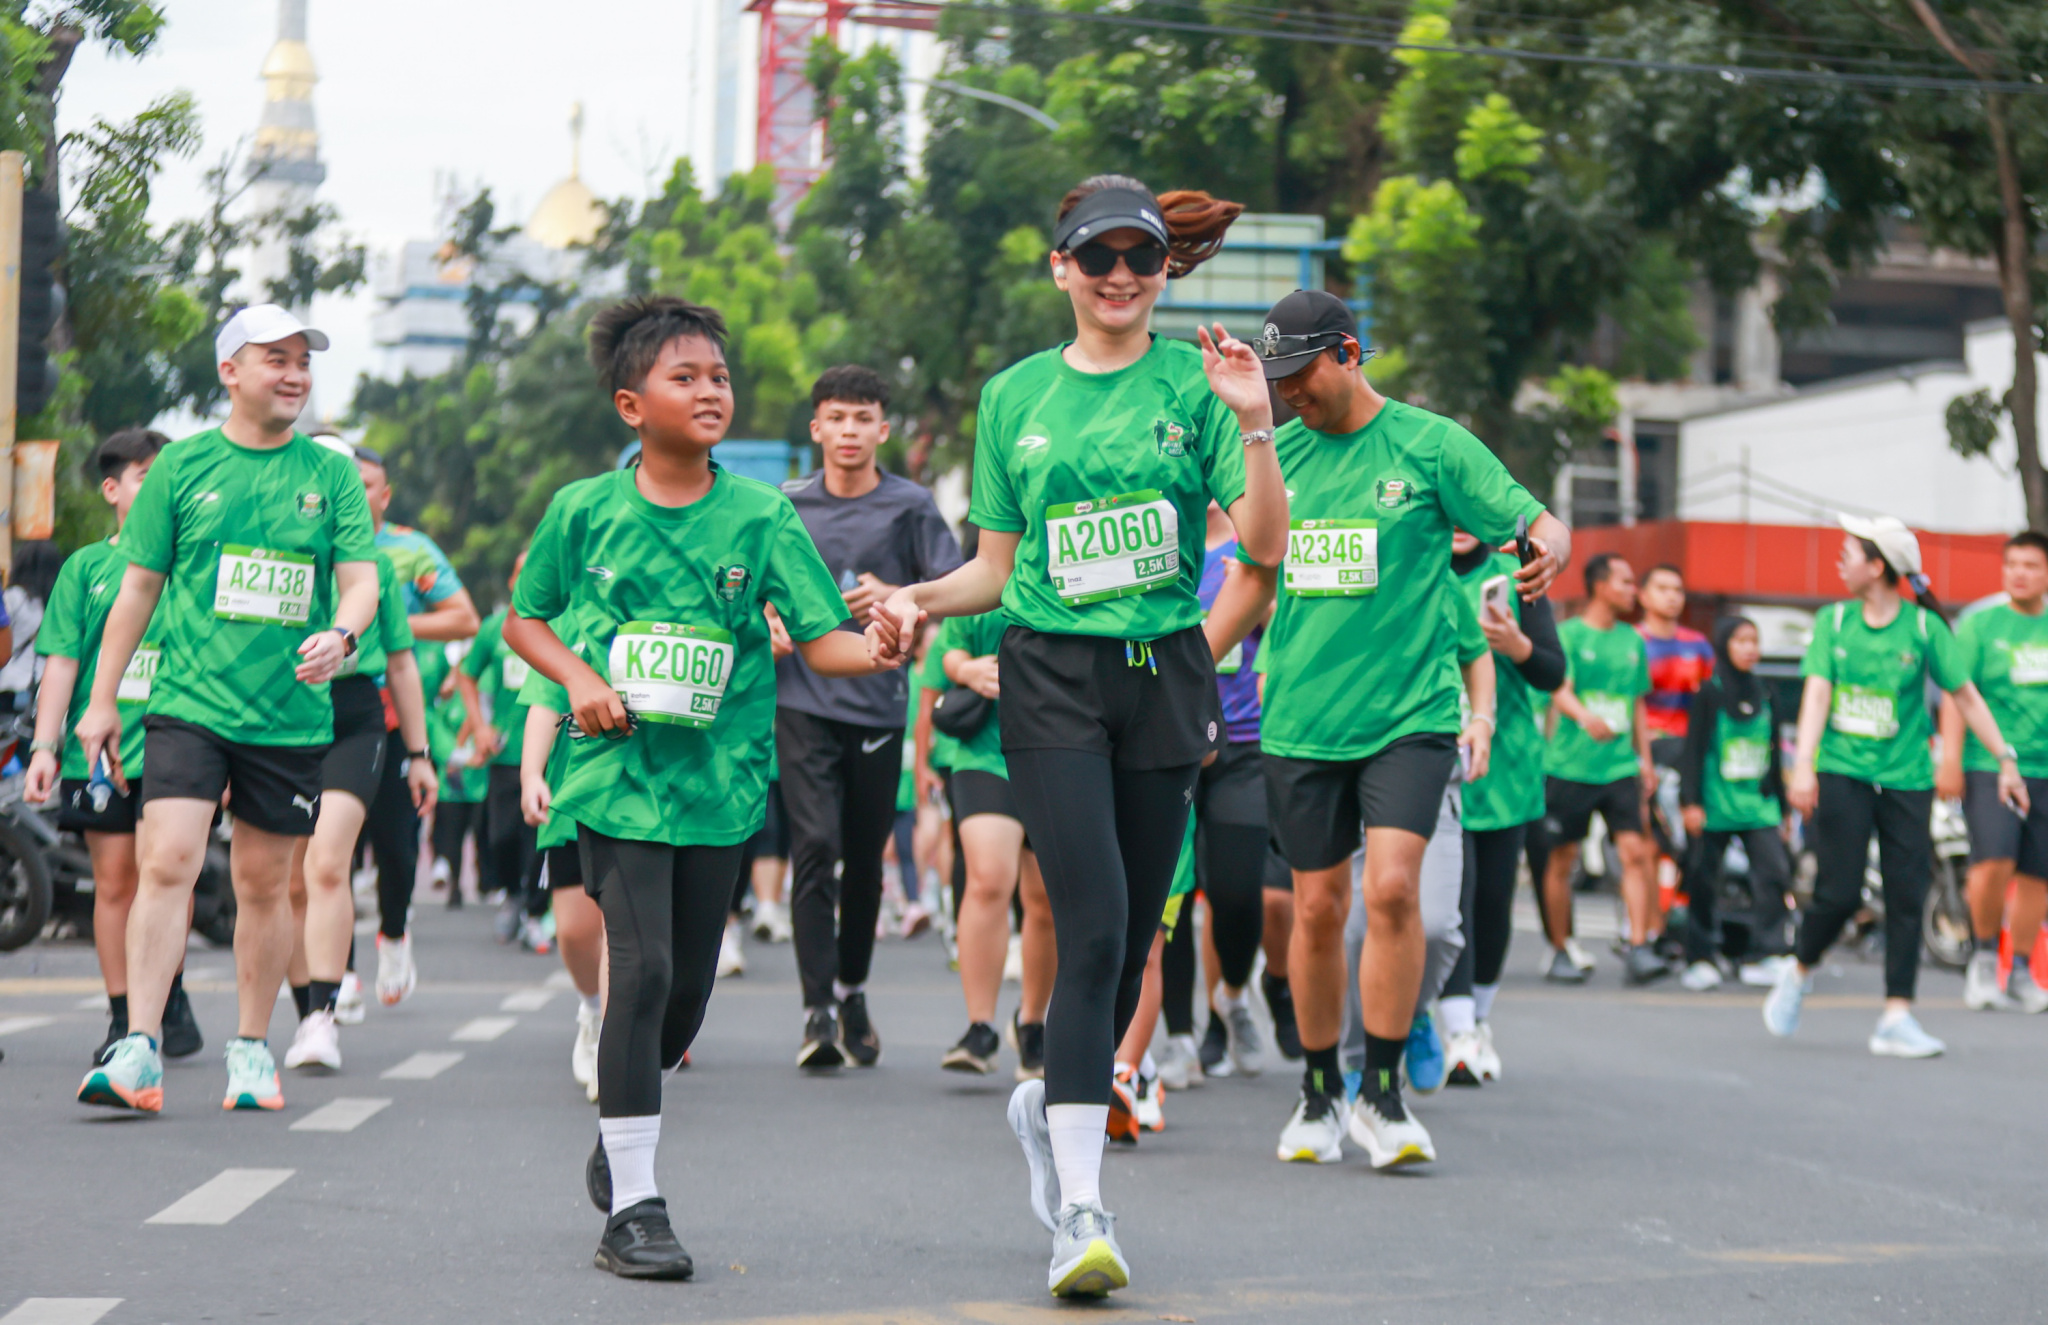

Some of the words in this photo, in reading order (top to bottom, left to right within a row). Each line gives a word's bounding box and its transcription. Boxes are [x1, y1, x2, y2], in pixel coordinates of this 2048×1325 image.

[1058, 508, 1163, 564] A2060
[1291, 533, 1363, 564] A2346
[229, 561, 306, 596] A2138
[1137, 557, 1164, 575] 2,5K
[1340, 571, 1361, 583] 2,5K
[626, 640, 724, 687] K2060
[693, 696, 713, 712] 2,5K
